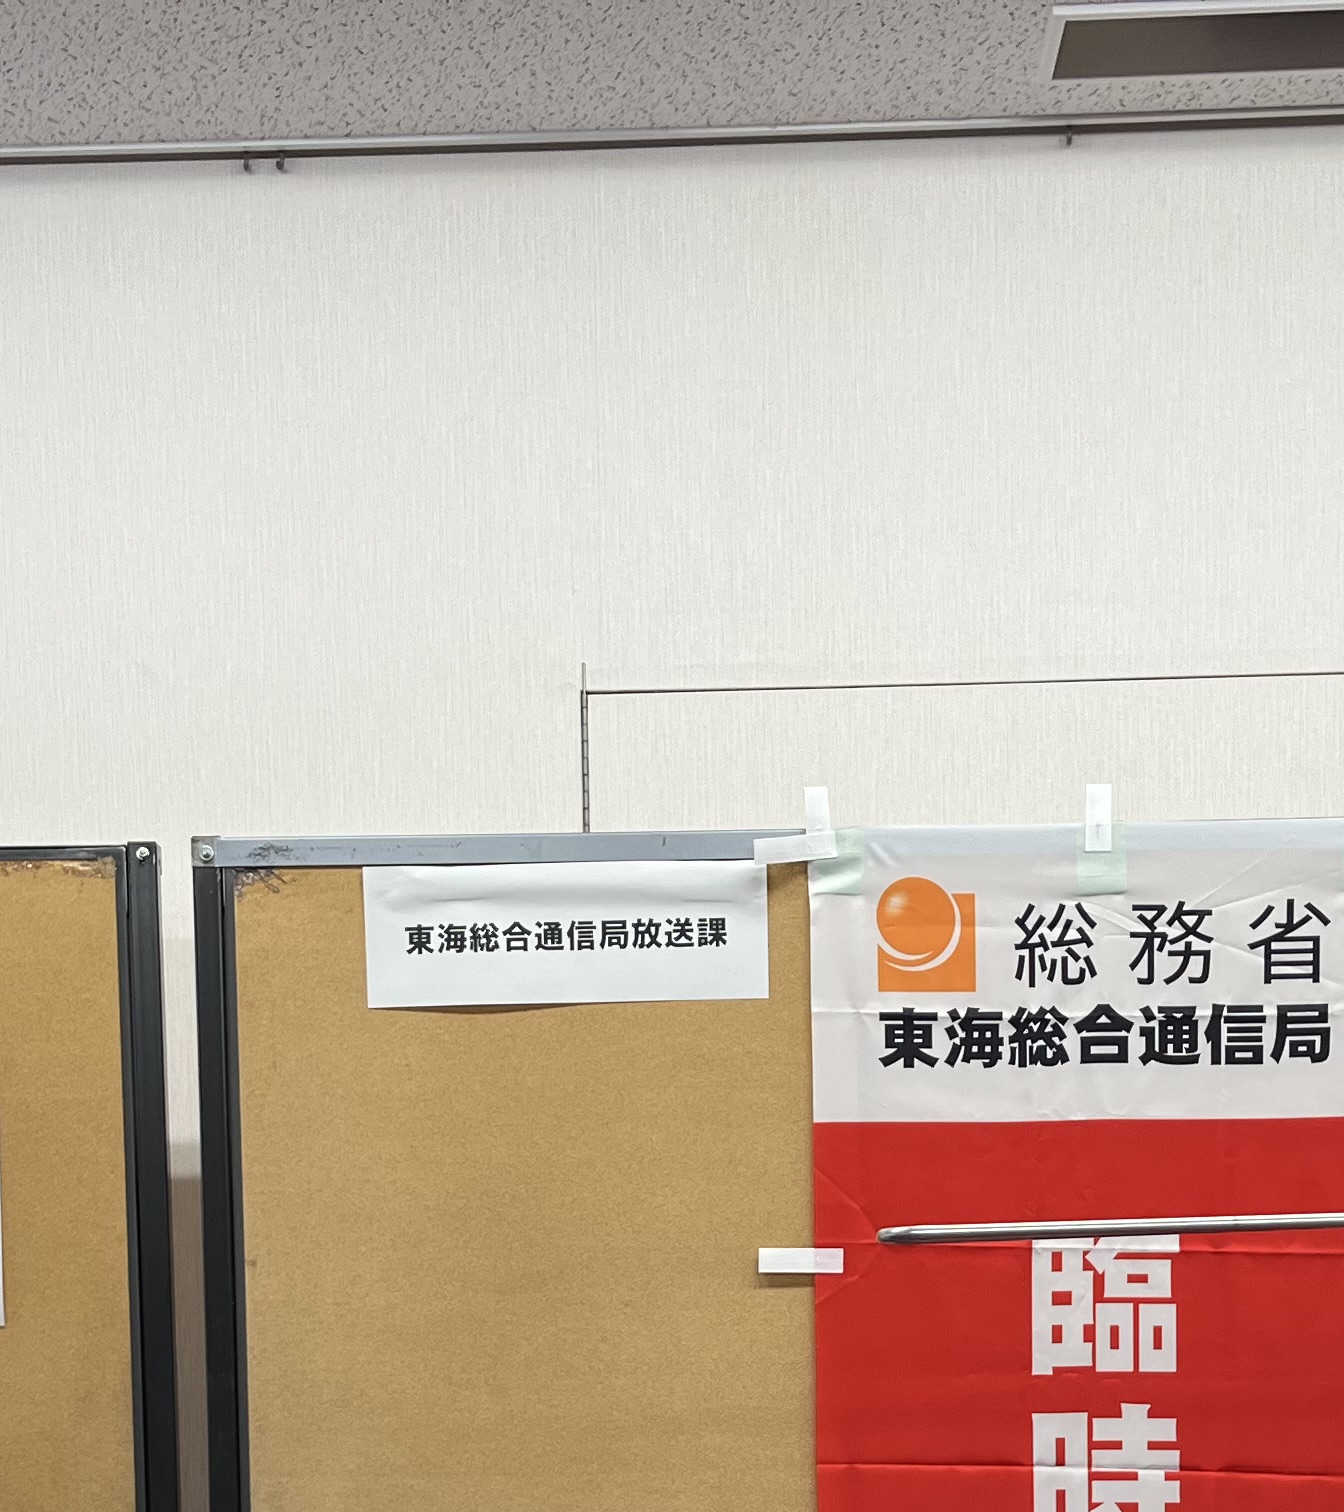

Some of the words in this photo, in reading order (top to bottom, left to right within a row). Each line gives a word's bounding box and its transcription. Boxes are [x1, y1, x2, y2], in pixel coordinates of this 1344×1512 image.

[405, 917, 728, 955] 東海総合通信局放送課
[1012, 898, 1332, 989] 総務省
[878, 1003, 1332, 1069] 東海総合通信局
